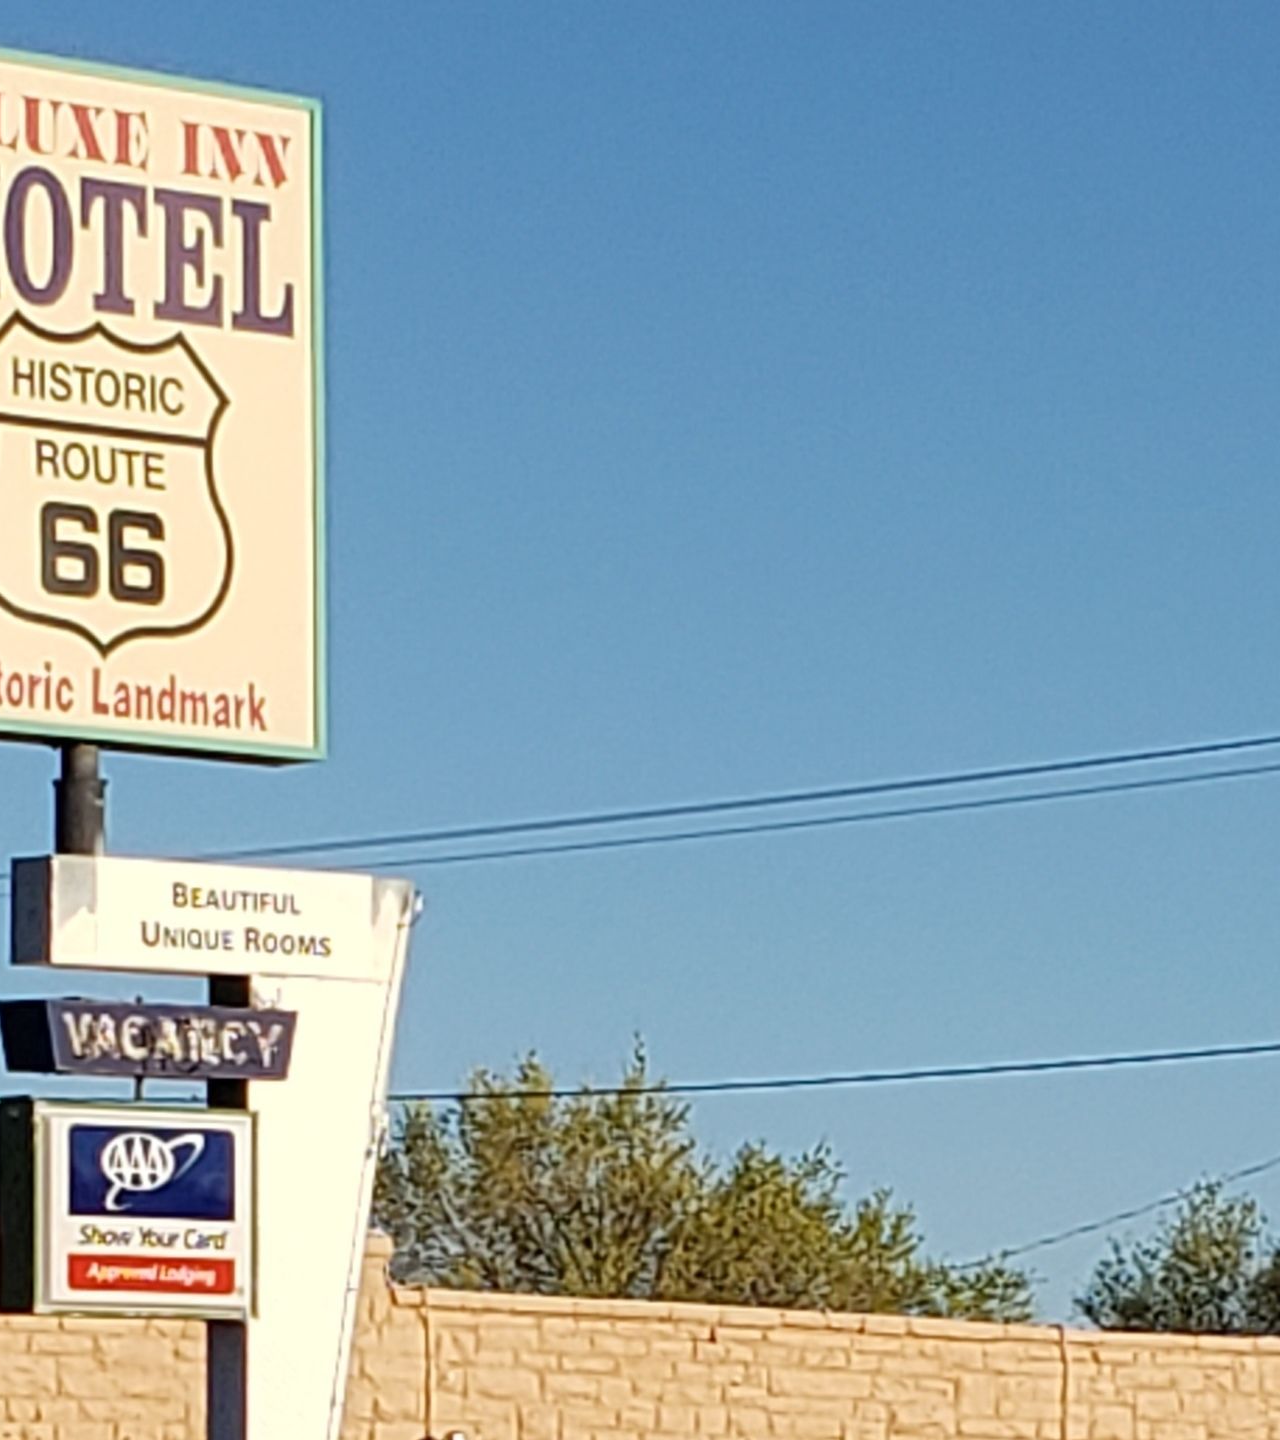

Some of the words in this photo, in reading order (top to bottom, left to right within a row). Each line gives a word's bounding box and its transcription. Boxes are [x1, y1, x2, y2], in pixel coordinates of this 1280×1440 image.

[180, 120, 292, 190] INN
[11, 356, 185, 417] HISTORIC
[34, 438, 167, 491] ROUTE
[40, 500, 166, 606] 66
[91, 667, 269, 732] Landmark
[172, 882, 301, 916] BEAUTIFUL
[141, 921, 236, 951] UNIQUE
[244, 927, 332, 957] ROOMS
[62, 1011, 284, 1069] VACANCY
[104, 1137, 173, 1182] AAA
[78, 1224, 133, 1247] Show
[138, 1226, 180, 1248] Your
[184, 1228, 228, 1250] Card
[86, 1261, 158, 1283] Approved
[159, 1264, 217, 1287] Lodging
